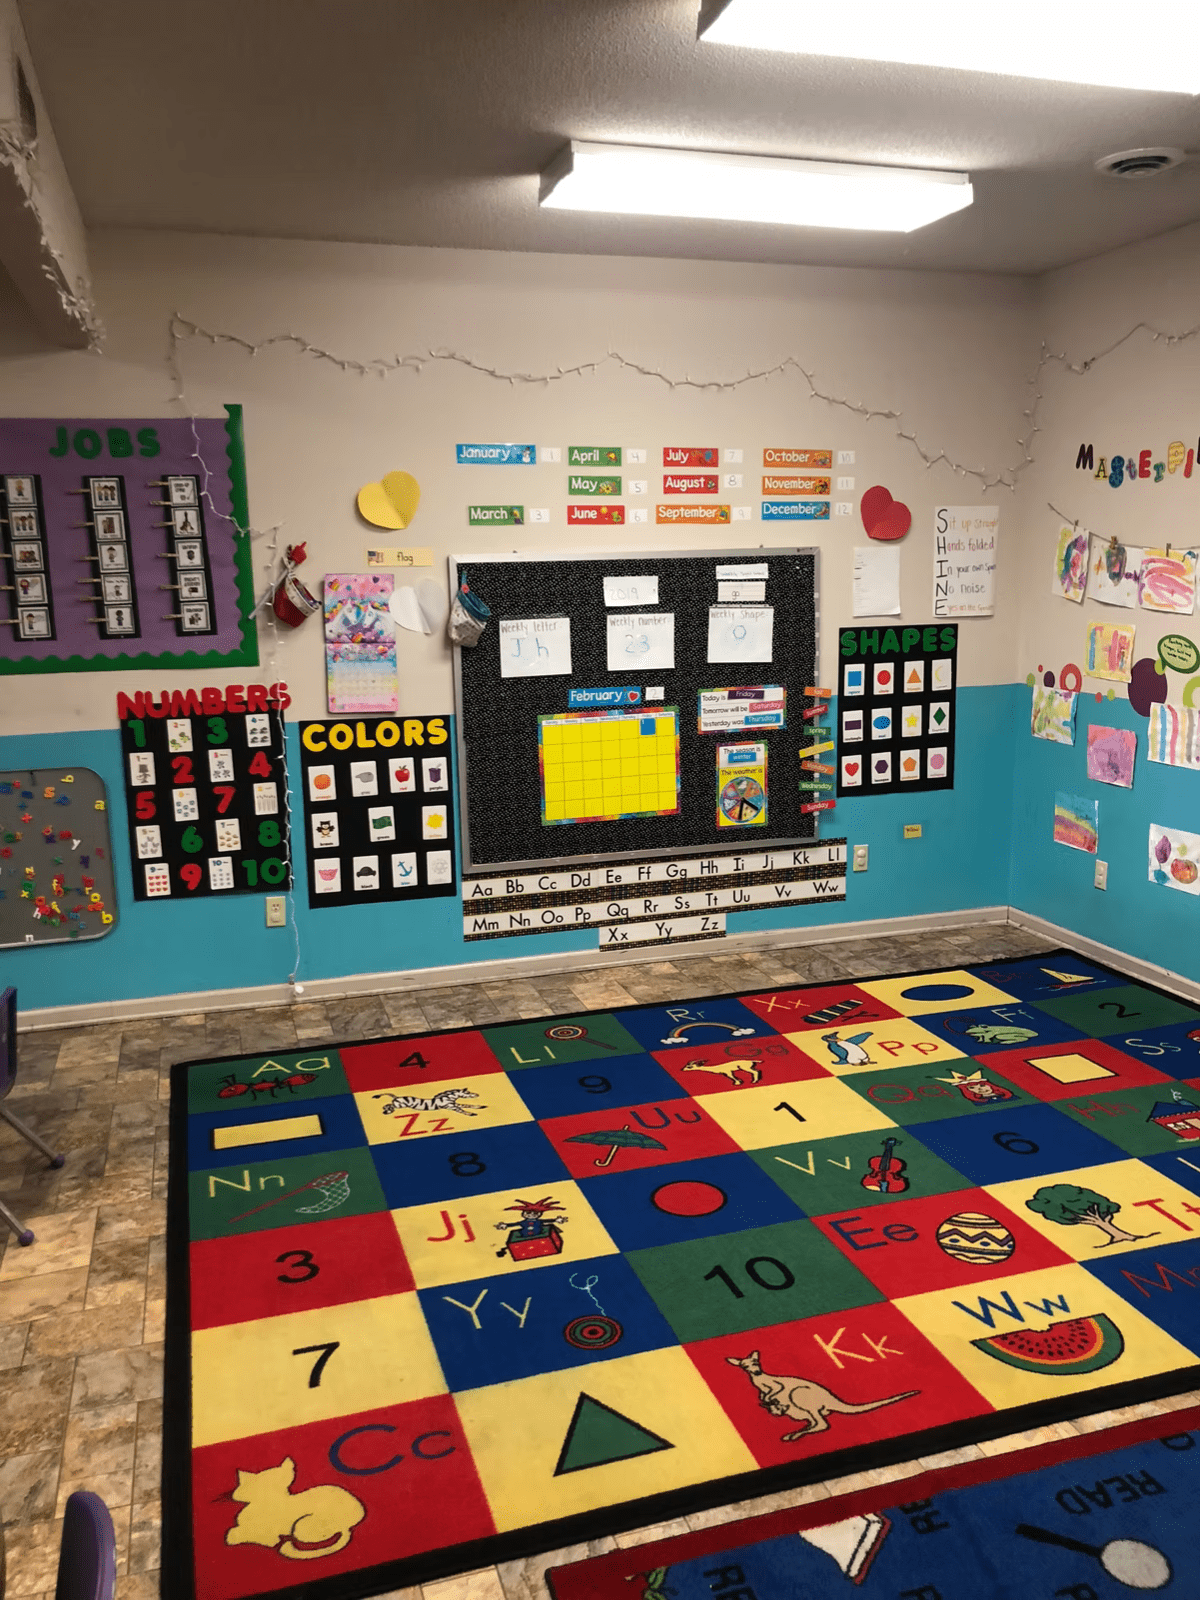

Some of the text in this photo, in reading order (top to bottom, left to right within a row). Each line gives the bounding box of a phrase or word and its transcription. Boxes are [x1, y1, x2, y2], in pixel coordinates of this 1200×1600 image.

[50, 424, 160, 459] JOBS
[460, 446, 511, 462] January
[571, 449, 600, 464] April
[631, 452, 640, 462] 4
[666, 449, 689, 464] July
[729, 451, 736, 460] 7
[765, 450, 810, 463] October
[571, 477, 598, 492] May
[634, 482, 641, 493] 5
[665, 477, 705, 492] August
[728, 477, 737, 487] 8
[764, 478, 816, 490] November
[470, 507, 508, 520] March
[535, 510, 543, 520] 3
[571, 507, 597, 520] June
[634, 511, 641, 522] 6
[658, 506, 717, 520] September
[763, 503, 816, 515] December
[838, 505, 849, 514] 12
[968, 535, 995, 552] folded
[397, 551, 414, 566] flag
[609, 587, 639, 600] 2019
[960, 582, 986, 594] noise
[609, 616, 635, 629] Weekly
[711, 609, 735, 621] Weekly
[501, 621, 529, 636] Weekly
[510, 637, 549, 658] J h
[625, 634, 651, 654] 23
[841, 627, 956, 656] SHAPES
[116, 682, 292, 720] NUMBERS
[570, 690, 623, 703] February
[651, 689, 658, 698] 2
[702, 694, 720, 702] Today
[127, 719, 147, 748] 1
[206, 716, 229, 745] 3
[302, 718, 448, 752] COLORS
[171, 755, 195, 784] 2
[248, 751, 272, 778] 4
[135, 790, 157, 820] 5
[212, 785, 236, 814] 7
[806, 801, 829, 810] Sunday
[181, 825, 204, 854] 6
[257, 819, 282, 848] 8
[71, 838, 81, 850] y
[180, 863, 203, 890] 9
[241, 857, 287, 887] 10
[471, 847, 840, 898] Aa Bb Cc Dd Ee Ff Gg Hh Ii Jj Kk Ll
[472, 880, 839, 932] Mm Nn Oo Pp Qq Rr Ss Tt Uu Vv Ww
[101, 910, 114, 925] b
[608, 917, 719, 942] Xx Yy Zz
[752, 996, 811, 1013] Xx
[1098, 1002, 1143, 1019] 2
[665, 1008, 705, 1022] Rr
[876, 1040, 939, 1057] Pp
[1125, 1038, 1182, 1056] Ss
[251, 1056, 331, 1078] Aa
[399, 1051, 431, 1069] 4
[577, 1075, 612, 1094] 9
[629, 1107, 702, 1130] Uu
[773, 1101, 806, 1122] 1
[393, 1112, 455, 1138] Zz
[992, 1132, 1040, 1155] 6
[447, 1152, 487, 1177] 8
[774, 1150, 851, 1176] Vv
[207, 1170, 285, 1198] Nn
[426, 1209, 476, 1243] Jj
[827, 1215, 919, 1251] Ee
[274, 1250, 320, 1284] 3
[704, 1255, 796, 1299] 10
[442, 1288, 532, 1330] Yy
[951, 1291, 1071, 1330] Ww
[812, 1326, 905, 1370] Kk
[292, 1341, 340, 1389] 7
[327, 1423, 457, 1477] Cc
[1055, 1469, 1167, 1516] READ
